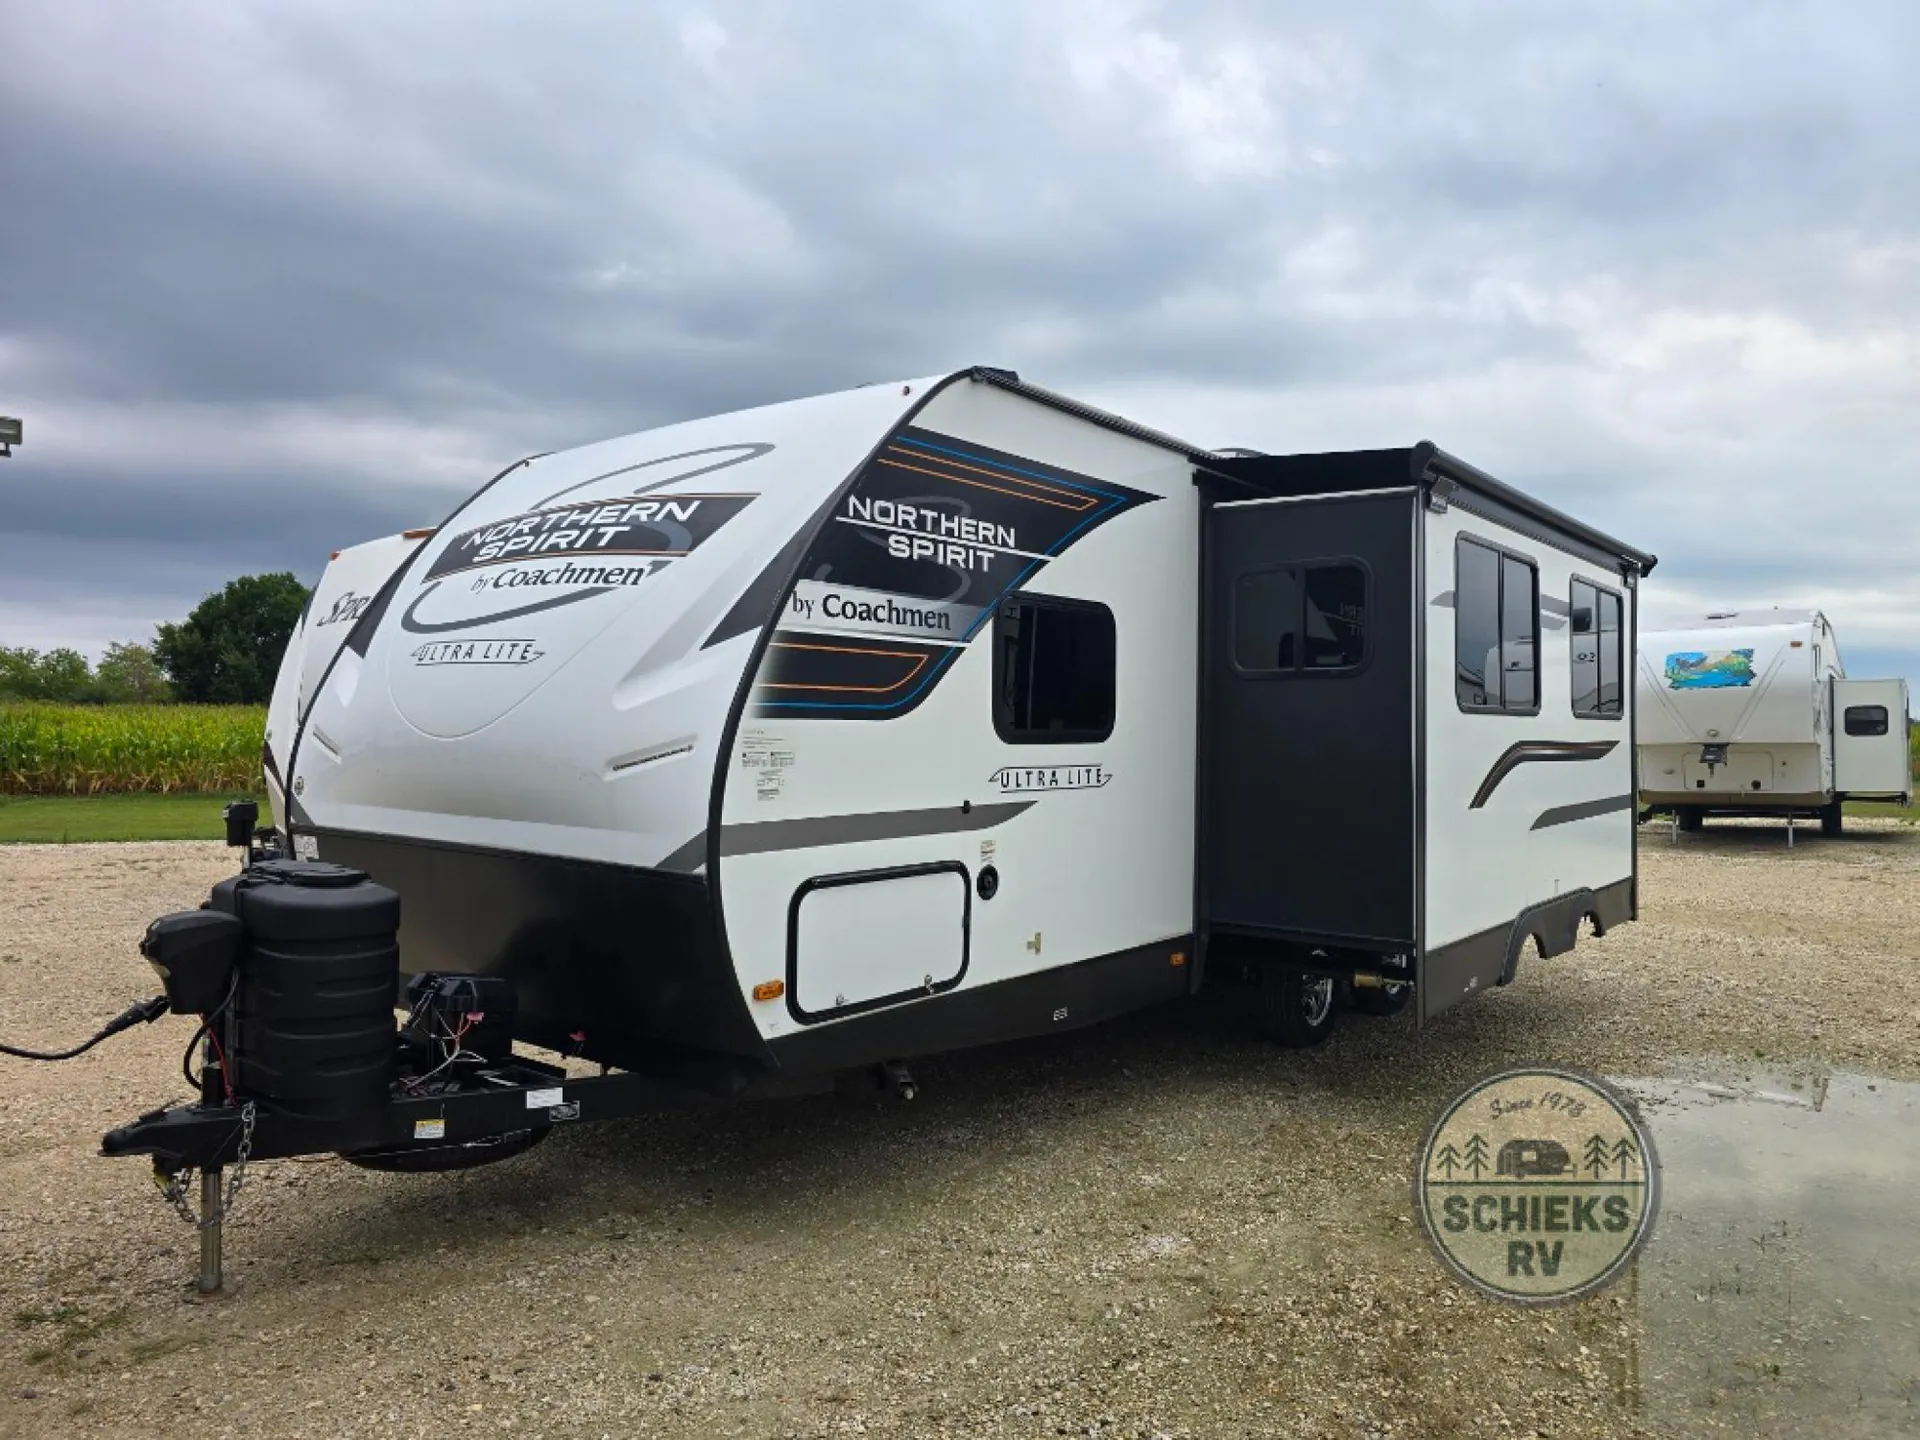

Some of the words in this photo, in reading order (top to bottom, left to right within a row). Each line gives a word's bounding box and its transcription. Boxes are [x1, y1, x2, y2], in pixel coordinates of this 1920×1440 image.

[461, 500, 702, 550] NORTHERN
[848, 494, 1016, 549] NORTHERN
[472, 526, 631, 563] SPIRIT
[888, 533, 995, 573] SPIRIT
[471, 573, 493, 598] by
[493, 562, 646, 590] Coachmen
[792, 588, 814, 620] by
[822, 593, 951, 631] Coachmen
[417, 643, 475, 661] ULTRA
[483, 642, 533, 661] LITE
[1001, 770, 1059, 788] ULTRA
[1068, 768, 1102, 785] LITE
